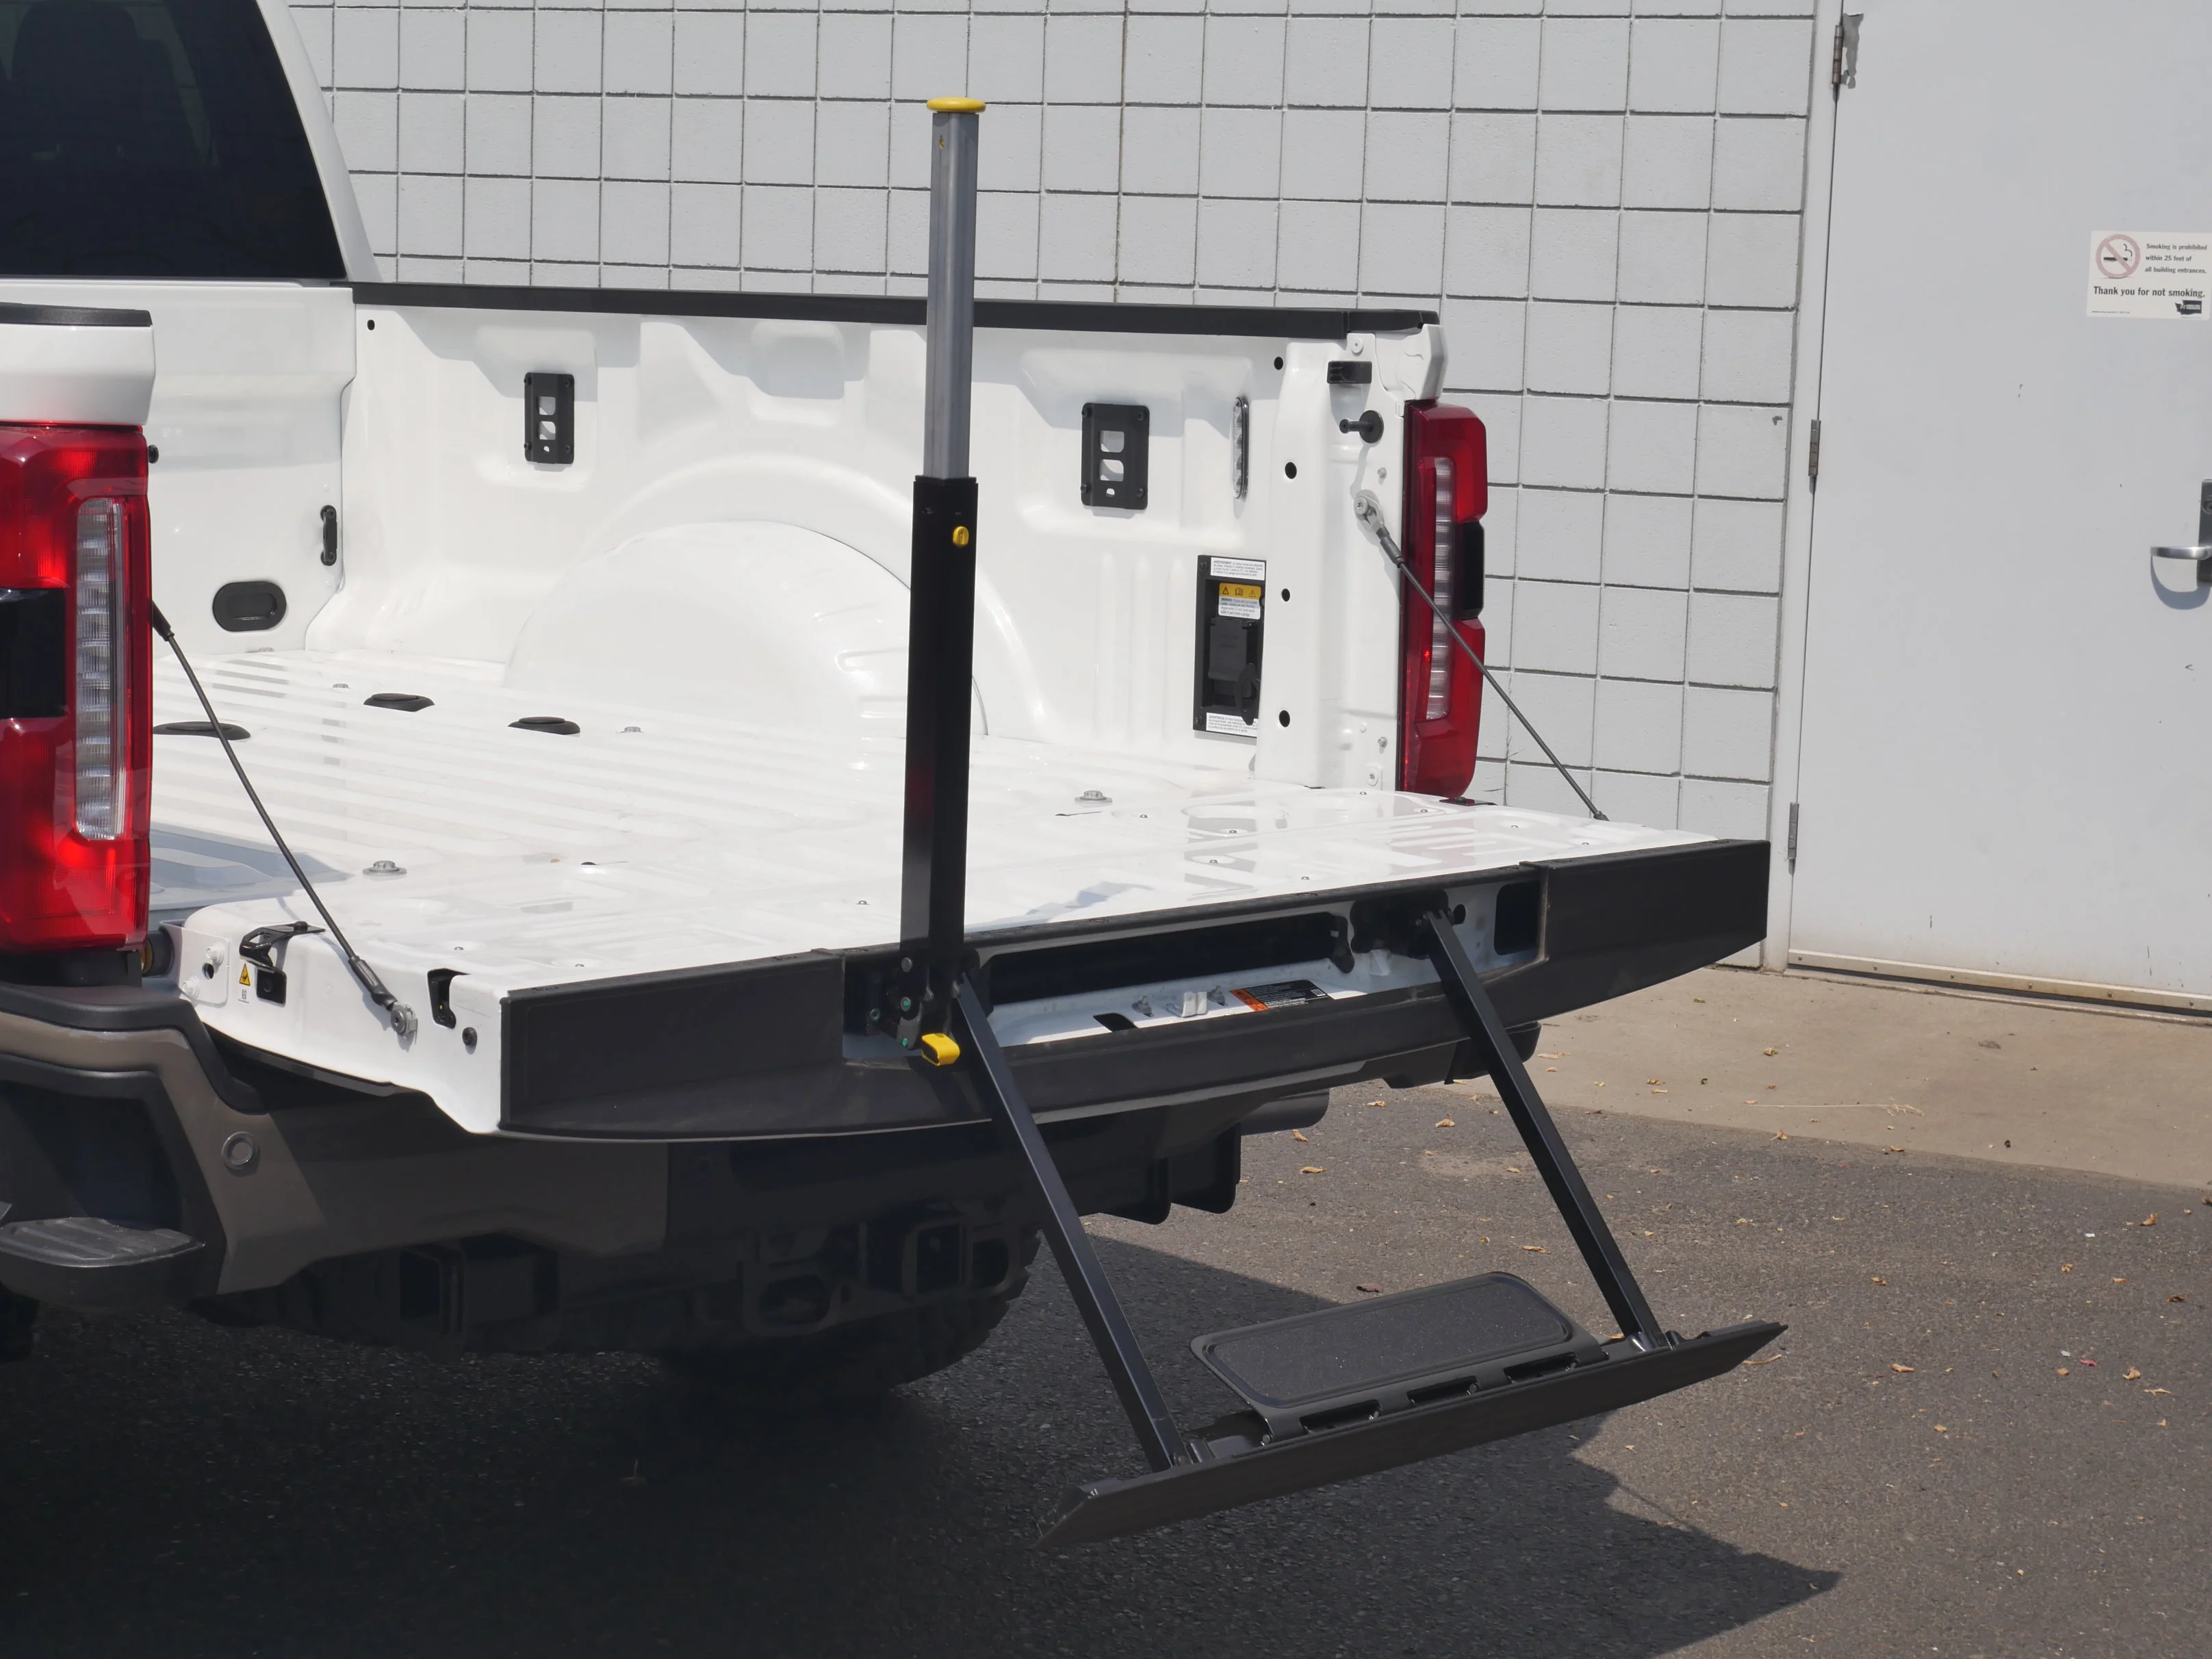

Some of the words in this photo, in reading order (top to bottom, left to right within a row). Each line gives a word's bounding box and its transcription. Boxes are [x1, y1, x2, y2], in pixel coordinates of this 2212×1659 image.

[2094, 286, 2118, 295] Thank
[2121, 288, 2135, 296] you
[2138, 287, 2150, 296] for
[2168, 288, 2205, 298] smoking.
